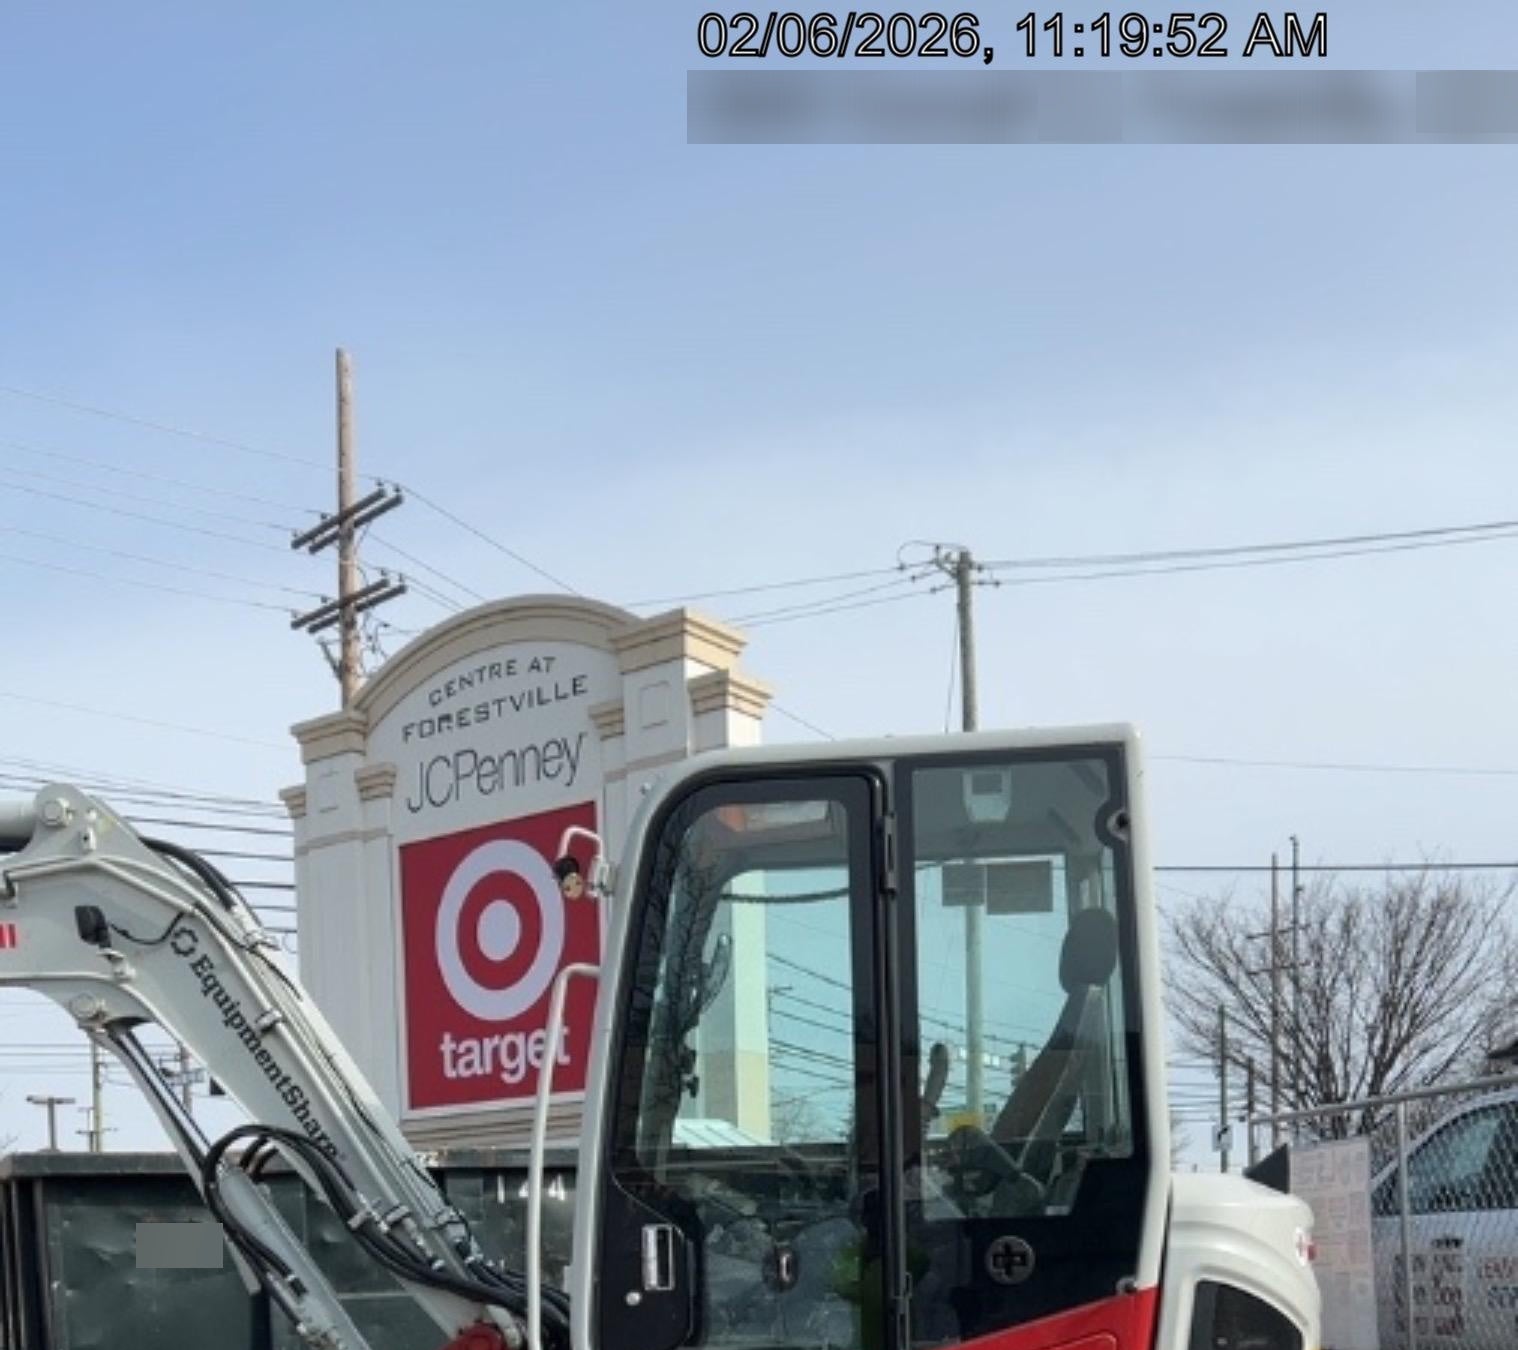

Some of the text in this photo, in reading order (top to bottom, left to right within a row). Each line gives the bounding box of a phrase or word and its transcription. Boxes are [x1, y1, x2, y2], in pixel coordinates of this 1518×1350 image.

[402, 674, 588, 744] FORESTVILLE
[428, 656, 556, 707] CENTRE AT
[407, 731, 588, 814] JCPenney
[439, 1026, 571, 1084] target
